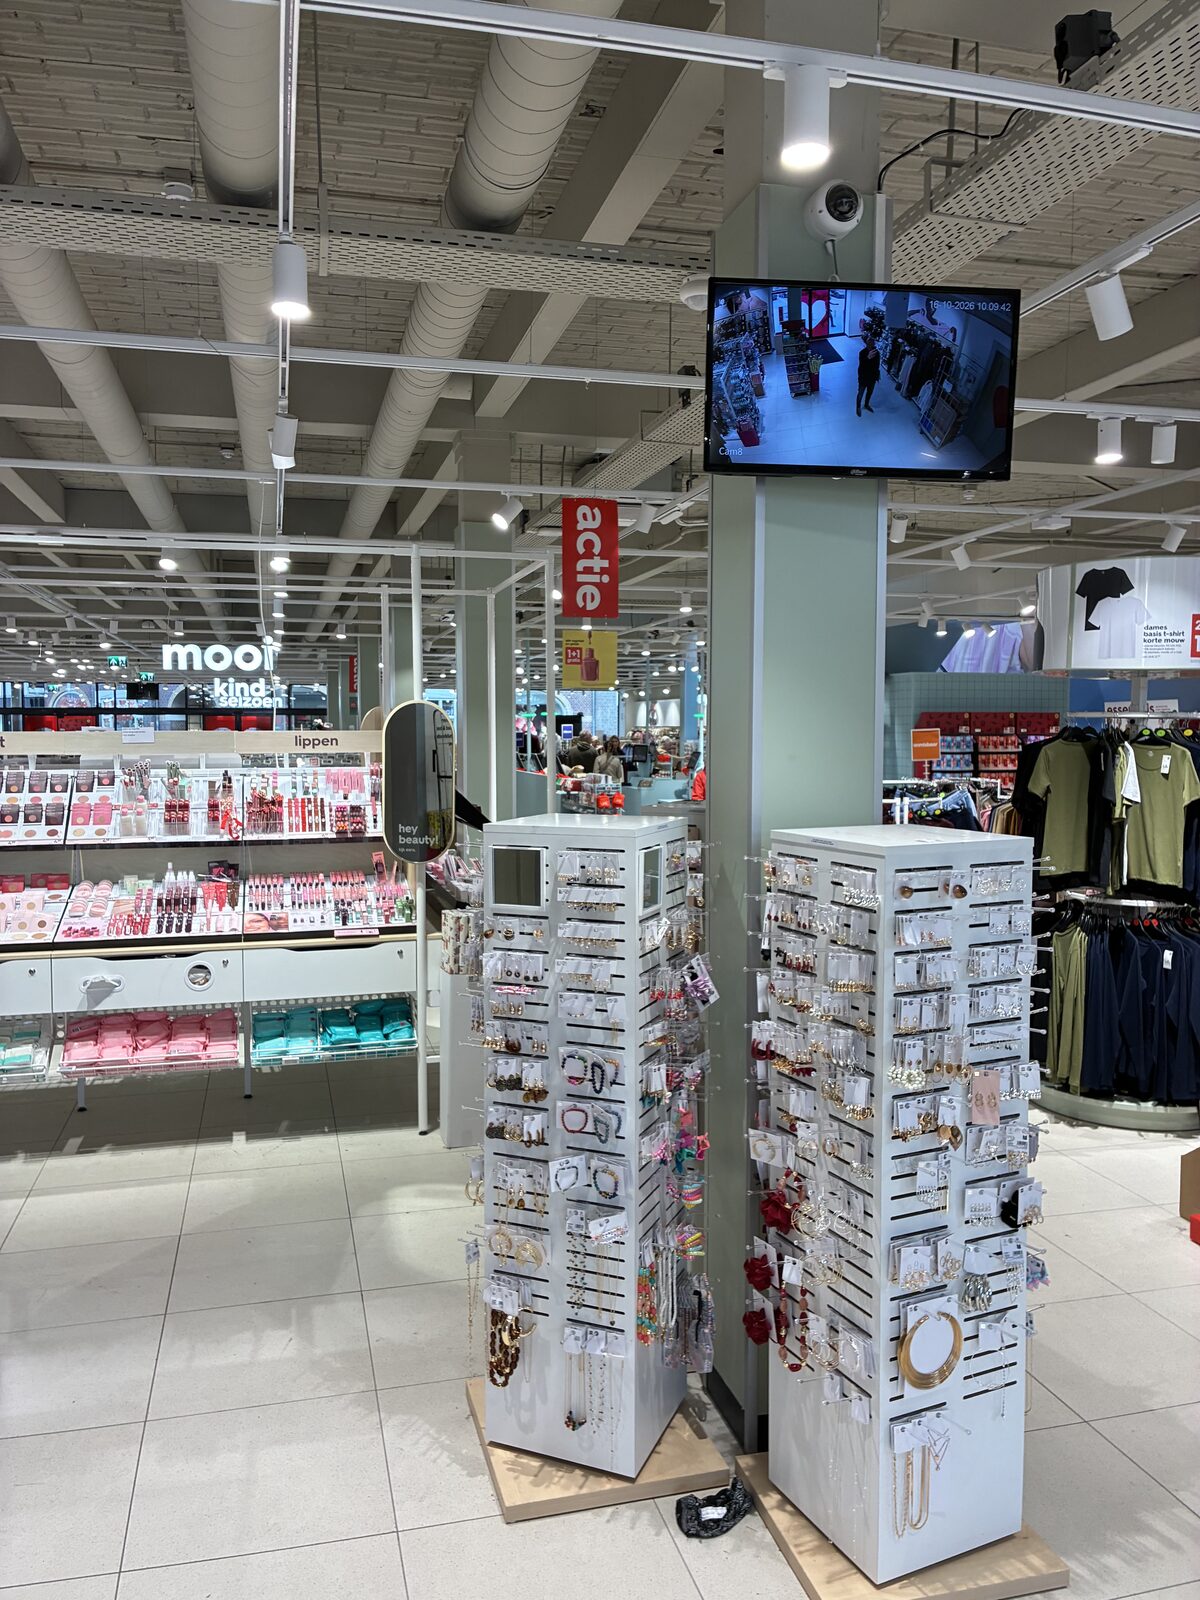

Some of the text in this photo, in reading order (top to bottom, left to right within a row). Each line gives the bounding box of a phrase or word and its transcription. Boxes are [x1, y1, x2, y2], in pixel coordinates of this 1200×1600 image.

[929, 300, 975, 309] 16-10-2026
[719, 447, 743, 455] Cam8
[576, 505, 610, 611] actie
[162, 636, 274, 671] mooi
[567, 649, 580, 658] 1+1
[213, 677, 266, 697] kind
[219, 694, 283, 708] seizoen
[294, 735, 339, 749] lippen
[398, 823, 418, 835] hey
[398, 835, 439, 846] beauty!
